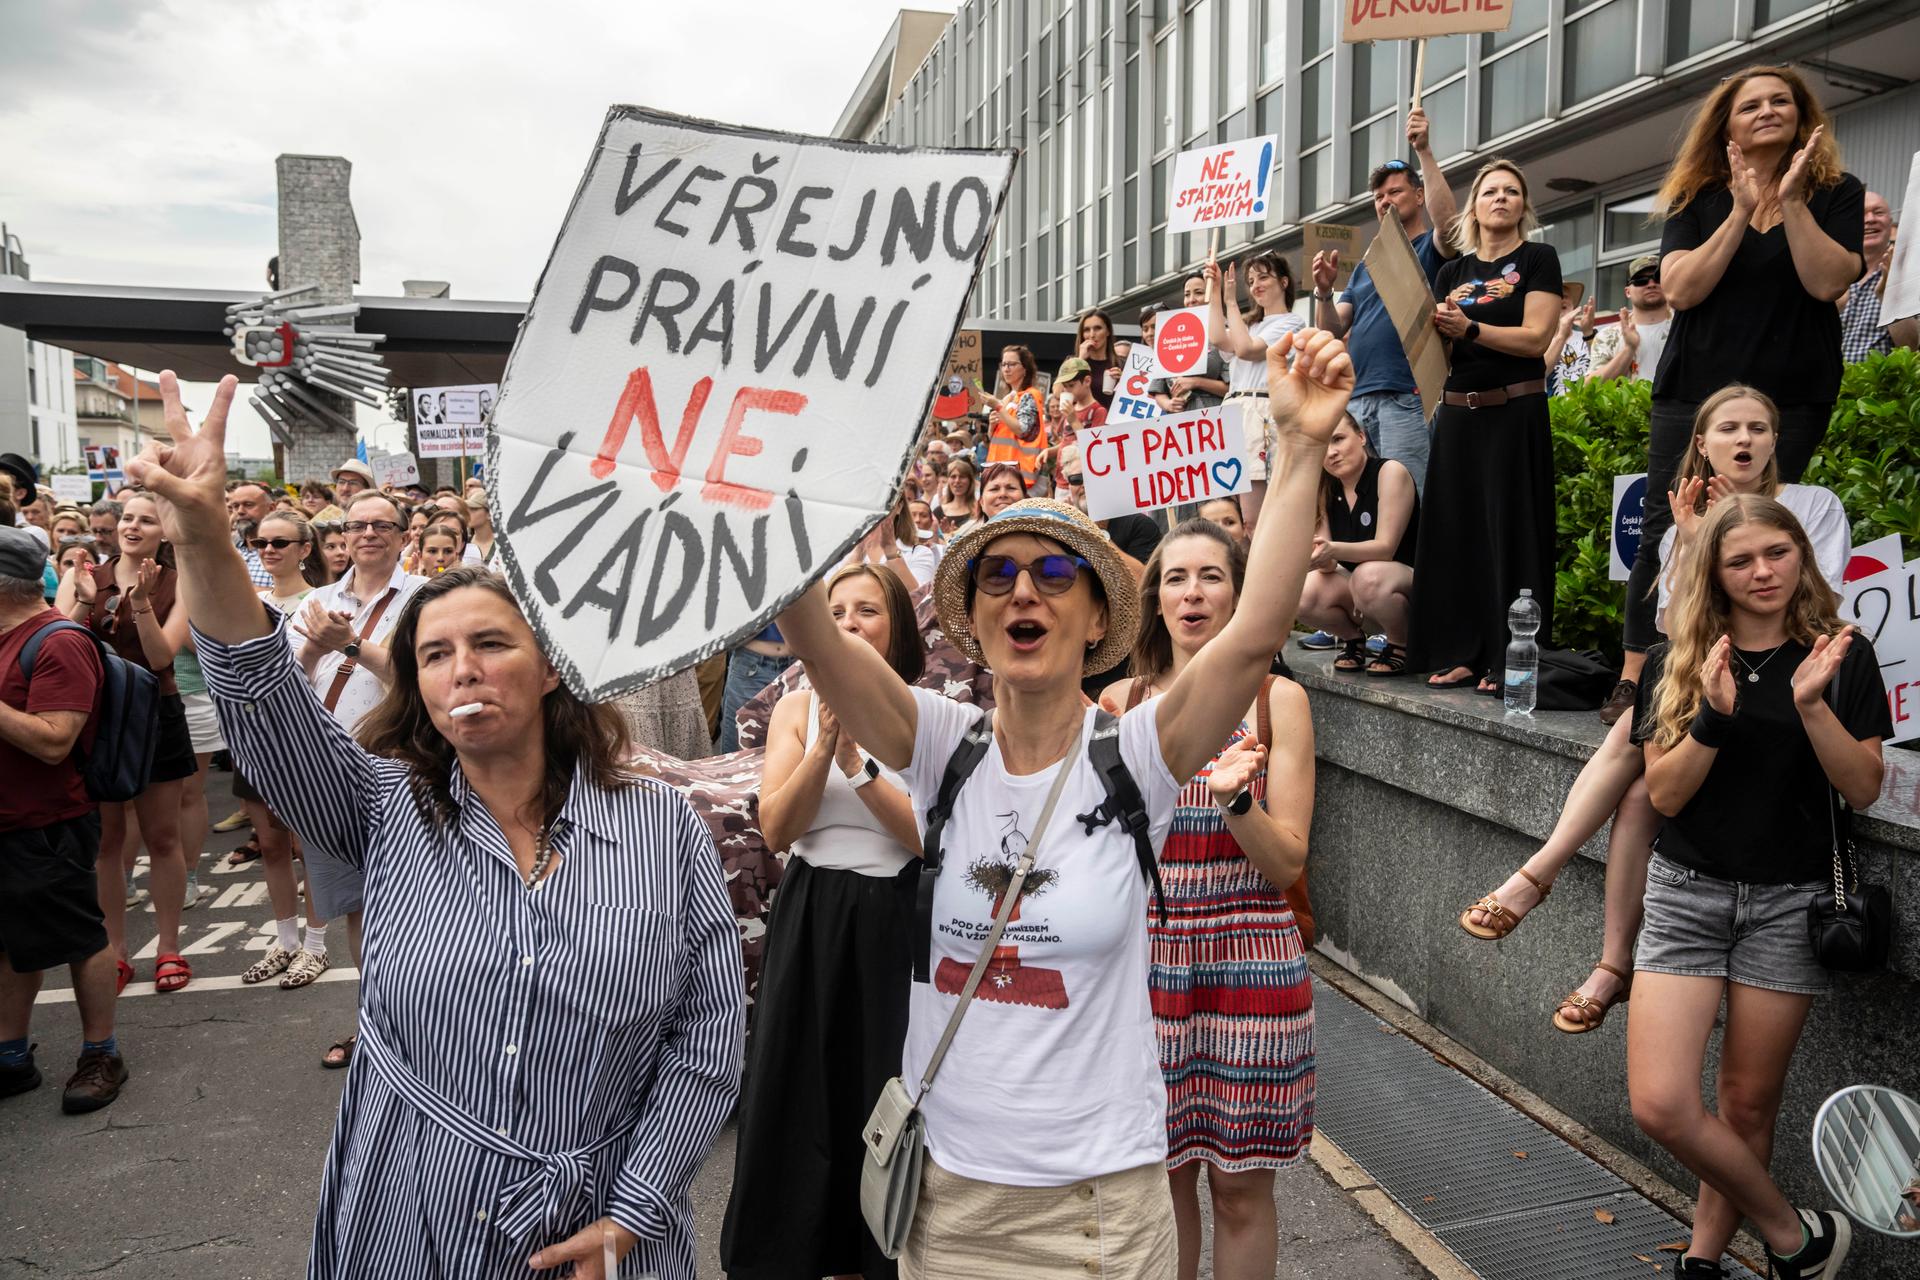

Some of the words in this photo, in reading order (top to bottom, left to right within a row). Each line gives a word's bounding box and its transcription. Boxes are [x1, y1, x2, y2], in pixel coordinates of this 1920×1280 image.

[615, 143, 993, 266] VEŘEJNO
[570, 255, 932, 388] PRÁVNÍ
[1119, 397, 1168, 419] TEL
[458, 427, 471, 438] NNÍ
[591, 367, 808, 509] NE
[1086, 430, 1130, 477] ČT
[1142, 406, 1225, 465] PATŘÍ
[1132, 461, 1210, 508] LIDEM
[507, 432, 811, 647] VLÁDNÍ
[1622, 515, 1638, 525] Česká
[939, 924, 963, 938] BÝVÁ
[1012, 933, 1062, 943] NASRÁNO.
[952, 918, 973, 930] POD
